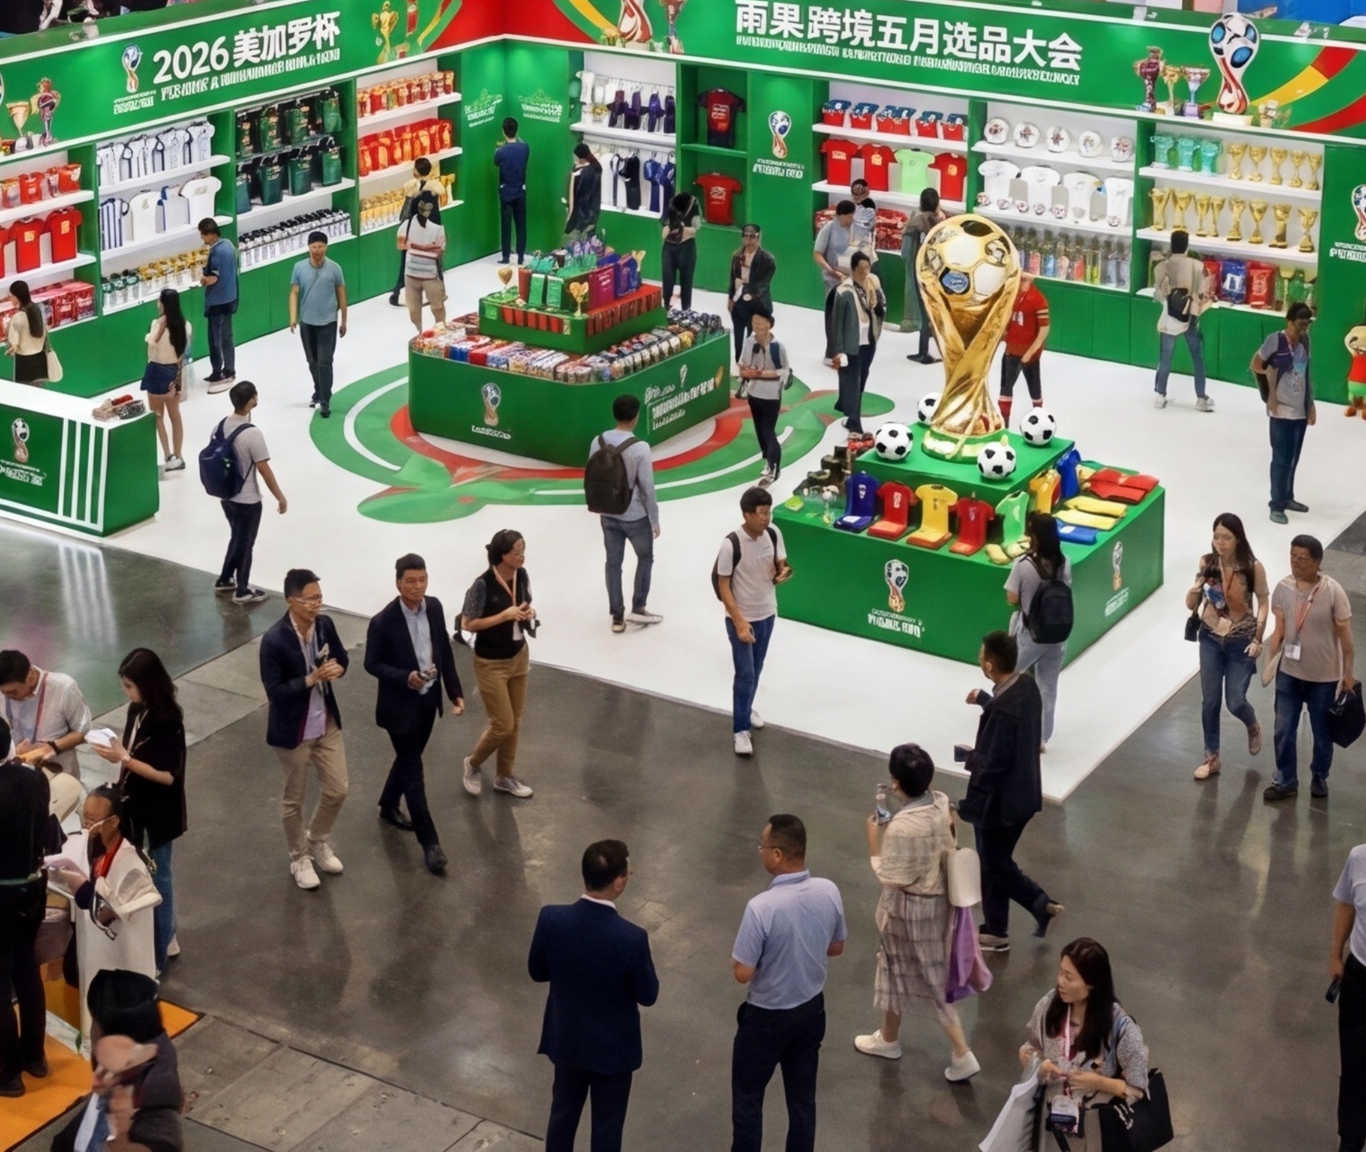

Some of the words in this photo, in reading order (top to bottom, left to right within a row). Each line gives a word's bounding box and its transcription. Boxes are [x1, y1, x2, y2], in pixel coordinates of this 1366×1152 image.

[735, 0, 1083, 71] 雨果跨境五月选品大会
